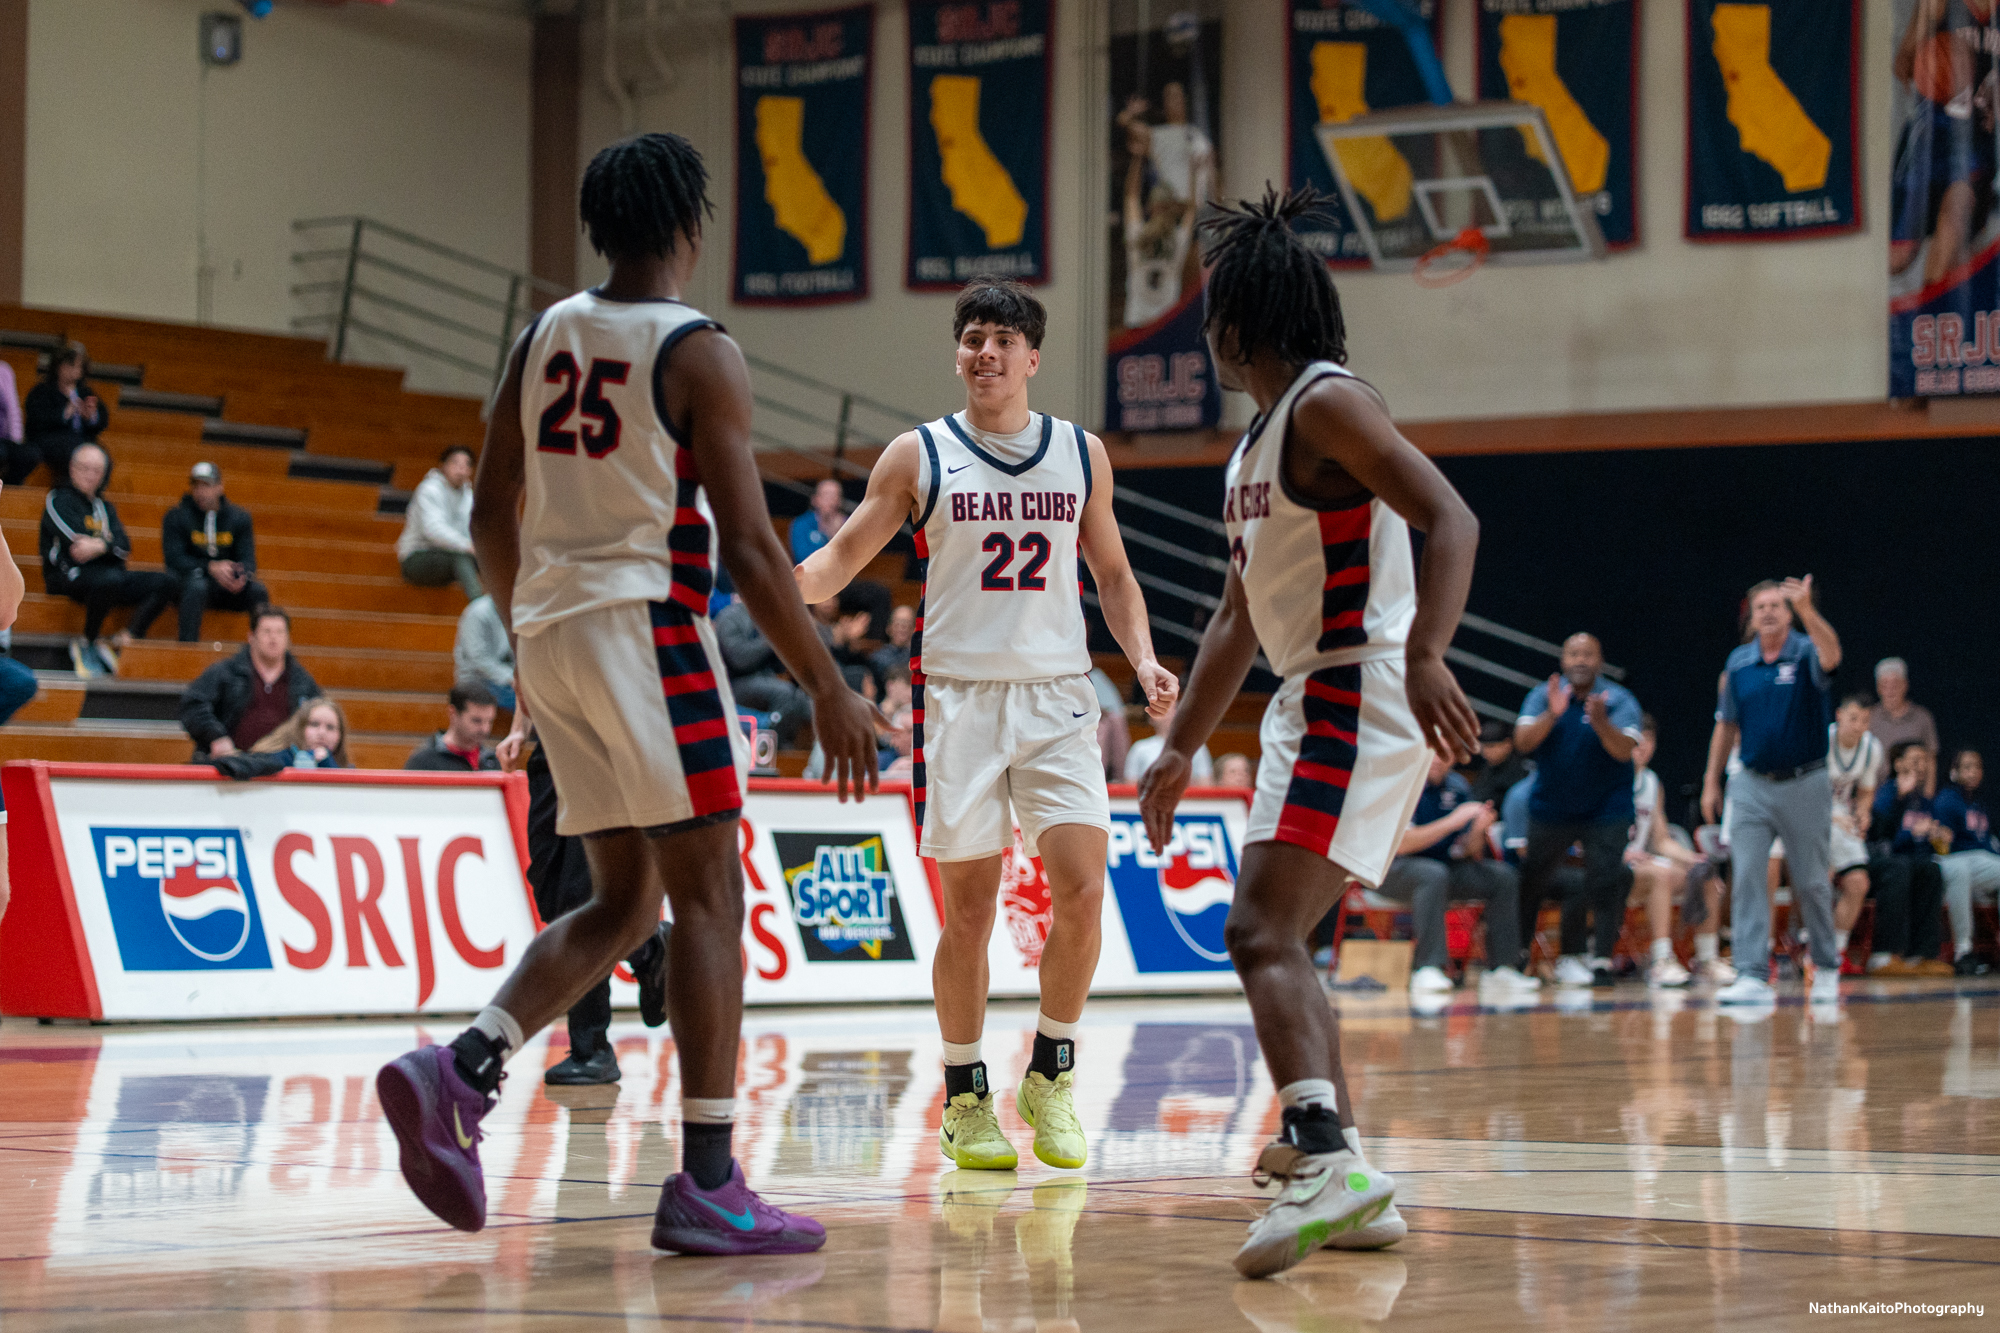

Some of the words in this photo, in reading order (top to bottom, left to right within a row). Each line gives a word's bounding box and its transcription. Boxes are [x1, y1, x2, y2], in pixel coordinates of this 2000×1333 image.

[537, 350, 631, 459] 25
[951, 492, 1014, 522] BEAR
[1021, 492, 1077, 523] CUBS
[981, 531, 1051, 591] 22
[105, 835, 238, 879] PEPSI
[816, 848, 866, 883] ALL
[1108, 821, 1228, 869] PEPSI
[273, 831, 507, 1011] SRJC
[796, 875, 890, 921] SPORT
